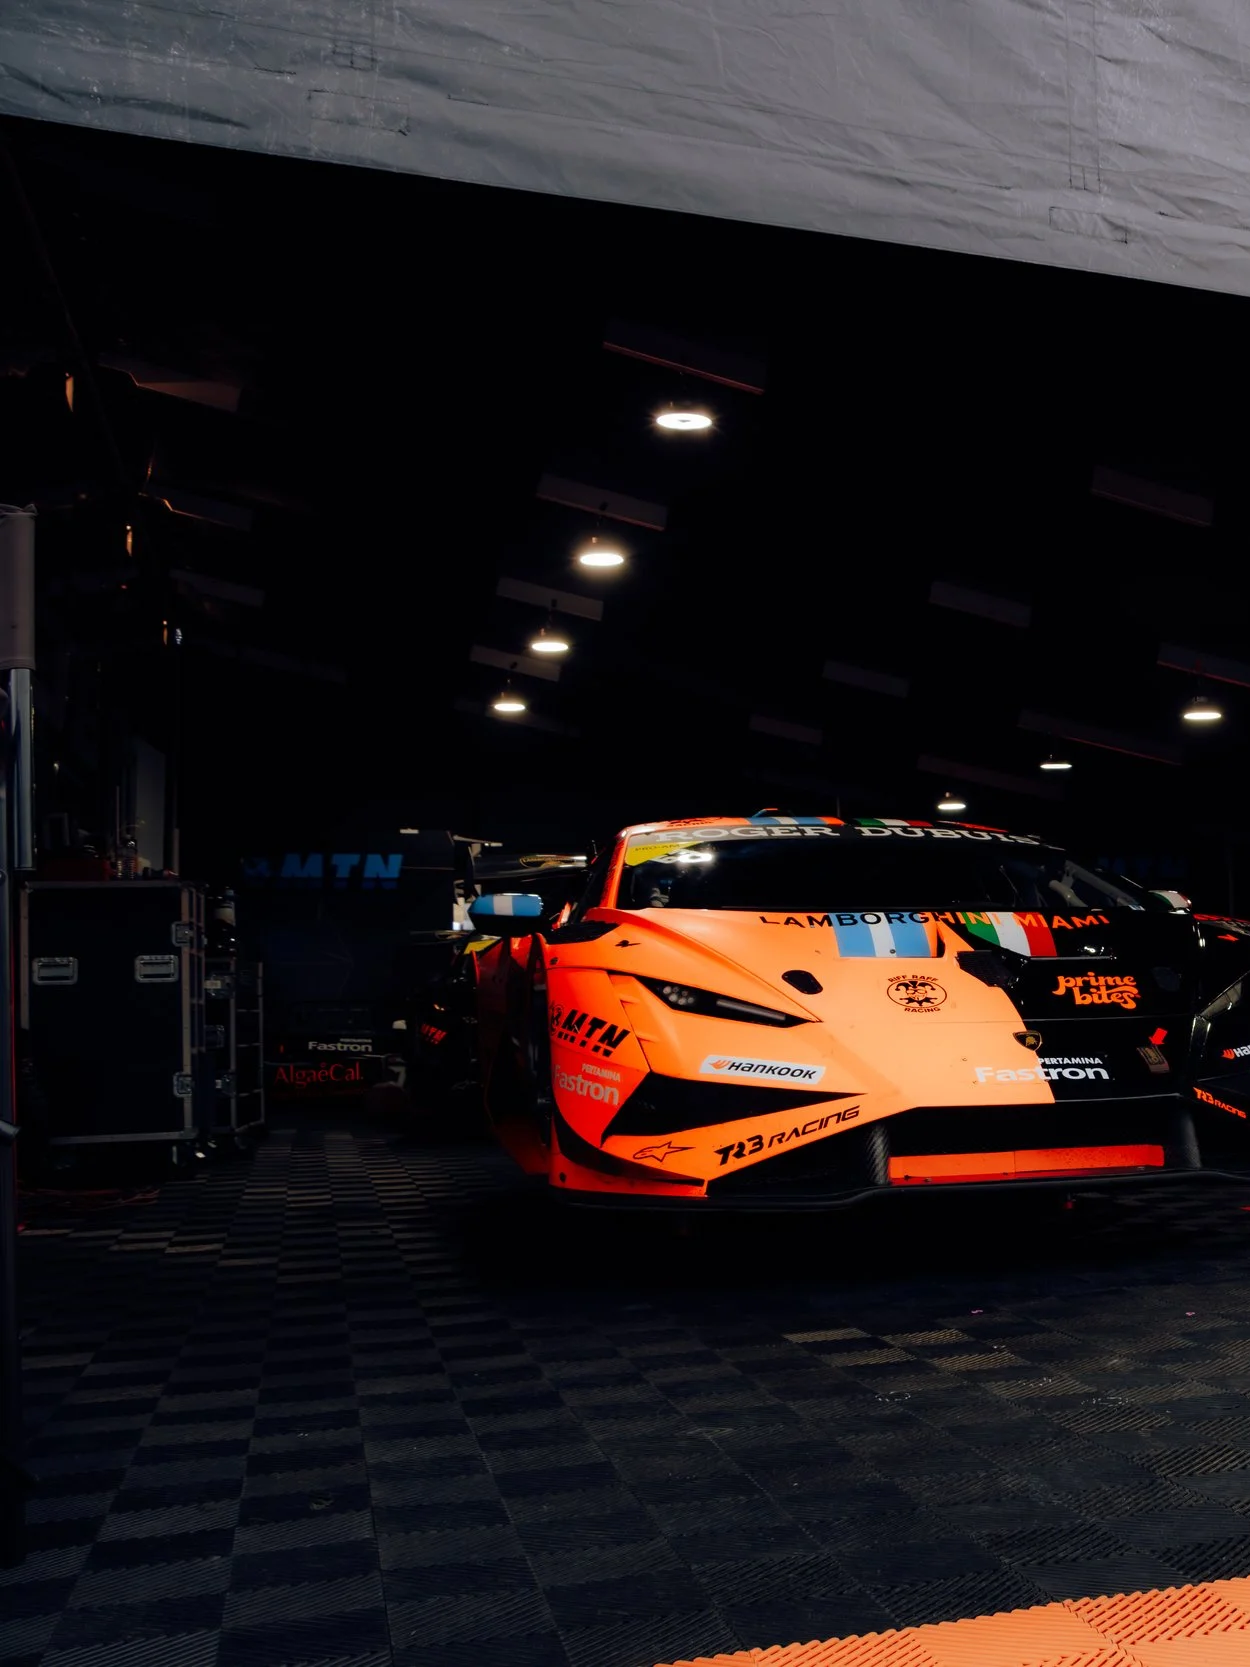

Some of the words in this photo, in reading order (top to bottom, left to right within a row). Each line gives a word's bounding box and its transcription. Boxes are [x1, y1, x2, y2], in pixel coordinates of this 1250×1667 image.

[655, 825, 840, 842] ROGER
[854, 826, 1041, 846] DUBUIS
[280, 852, 404, 890] MTN
[760, 911, 1002, 929] LAMBORGHINI
[1010, 911, 1111, 931] MIAMI
[887, 974, 908, 983] RIFF
[911, 974, 938, 982] RAFF
[1052, 971, 1137, 996] prime
[1073, 985, 1140, 1010] bites
[904, 1006, 941, 1014] RACING
[557, 1008, 632, 1058] MTN
[307, 1040, 373, 1052] Fastron
[1038, 1056, 1103, 1065] PERTAMINA
[975, 1066, 1110, 1083] Fastron
[1211, 1098, 1247, 1120] RACING
[714, 1134, 764, 1166] TR3
[767, 1104, 861, 1149] RACING
